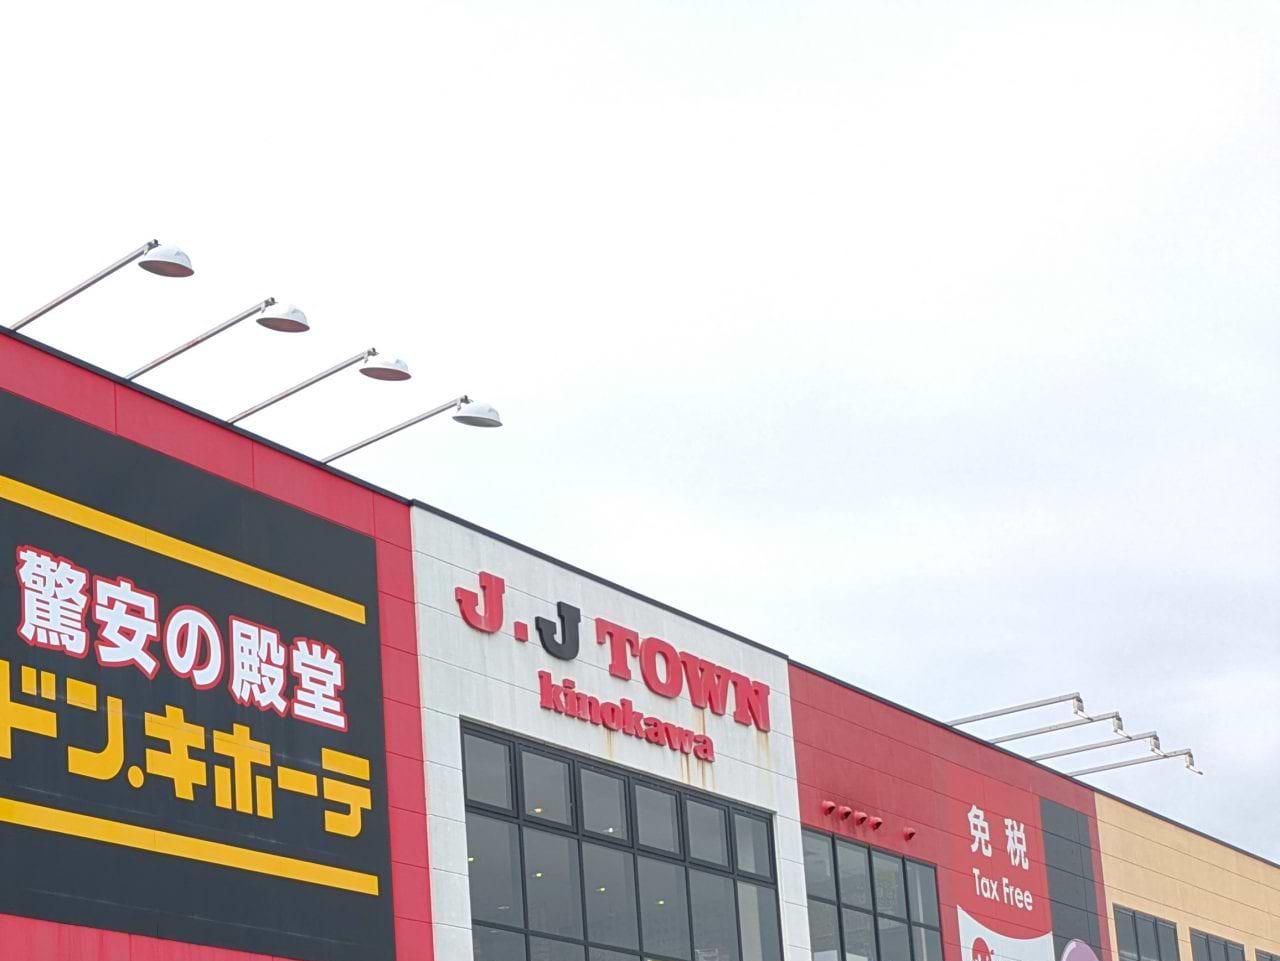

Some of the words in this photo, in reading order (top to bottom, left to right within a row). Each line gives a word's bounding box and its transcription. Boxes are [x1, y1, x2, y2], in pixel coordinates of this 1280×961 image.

[17, 546, 348, 732] 驚安の殿堂
[594, 617, 771, 733] TOWN
[538, 670, 715, 763] kinokawa
[967, 804, 1029, 870] 免税
[972, 867, 1000, 902] Tax
[1002, 877, 1034, 911] Free
